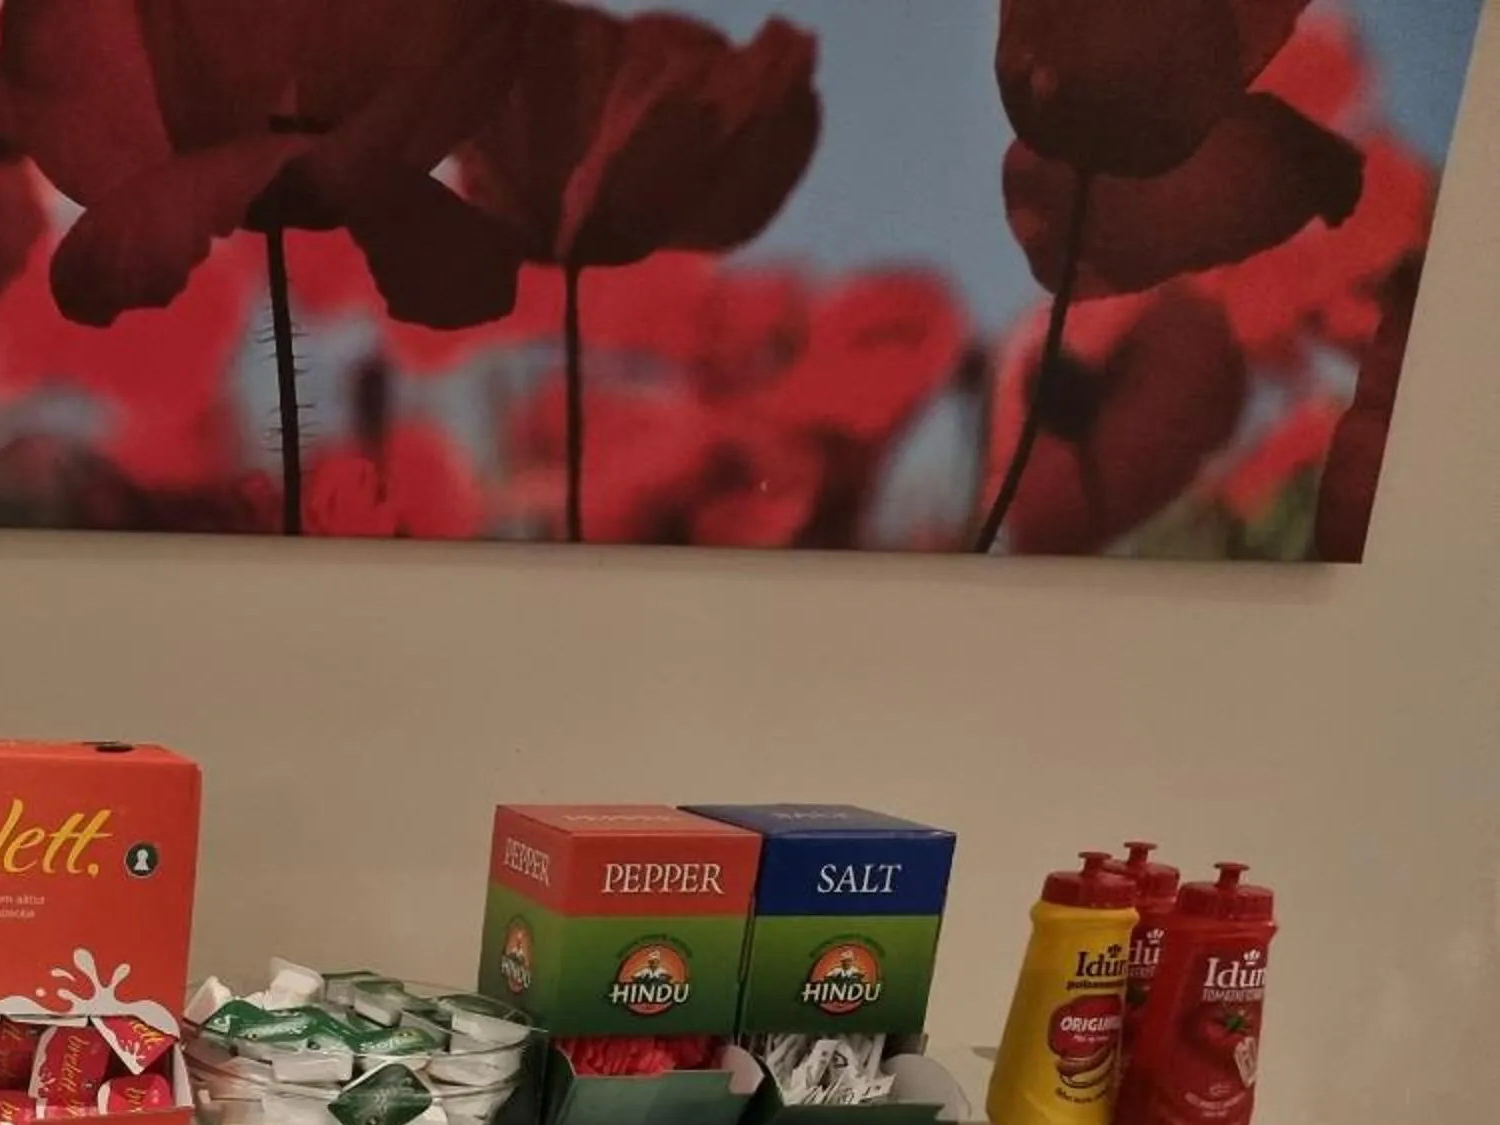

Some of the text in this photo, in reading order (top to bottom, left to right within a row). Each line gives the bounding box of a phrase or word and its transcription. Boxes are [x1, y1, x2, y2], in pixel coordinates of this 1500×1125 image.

[504, 837, 550, 888] PEPPER
[817, 863, 902, 893] SALT
[602, 862, 726, 895] PEPPER
[501, 957, 531, 989] HINDU
[608, 982, 690, 1004] HINDU
[802, 981, 882, 1003] HINDU
